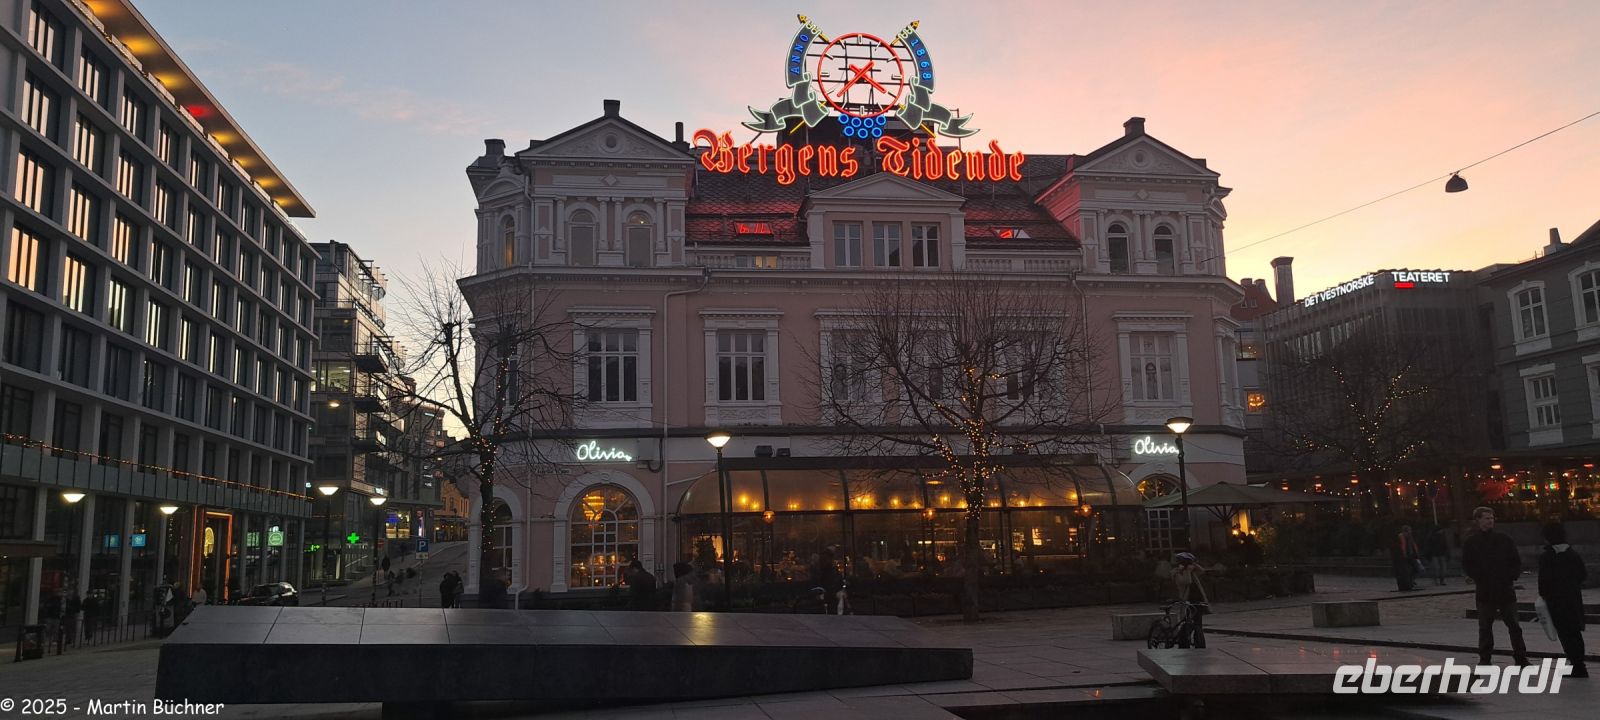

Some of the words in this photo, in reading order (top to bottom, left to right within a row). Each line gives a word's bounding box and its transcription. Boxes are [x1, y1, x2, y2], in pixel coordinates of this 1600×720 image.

[790, 33, 809, 75] ANNO
[910, 38, 932, 81] 1868
[693, 128, 859, 185] Bergens
[877, 136, 1025, 181] Tidende
[1304, 295, 1319, 308] DET
[1320, 274, 1375, 302] VESTNORSKE
[1391, 271, 1450, 283] TEATERET
[577, 440, 632, 461] Olivia
[1135, 436, 1179, 454] Olivia
